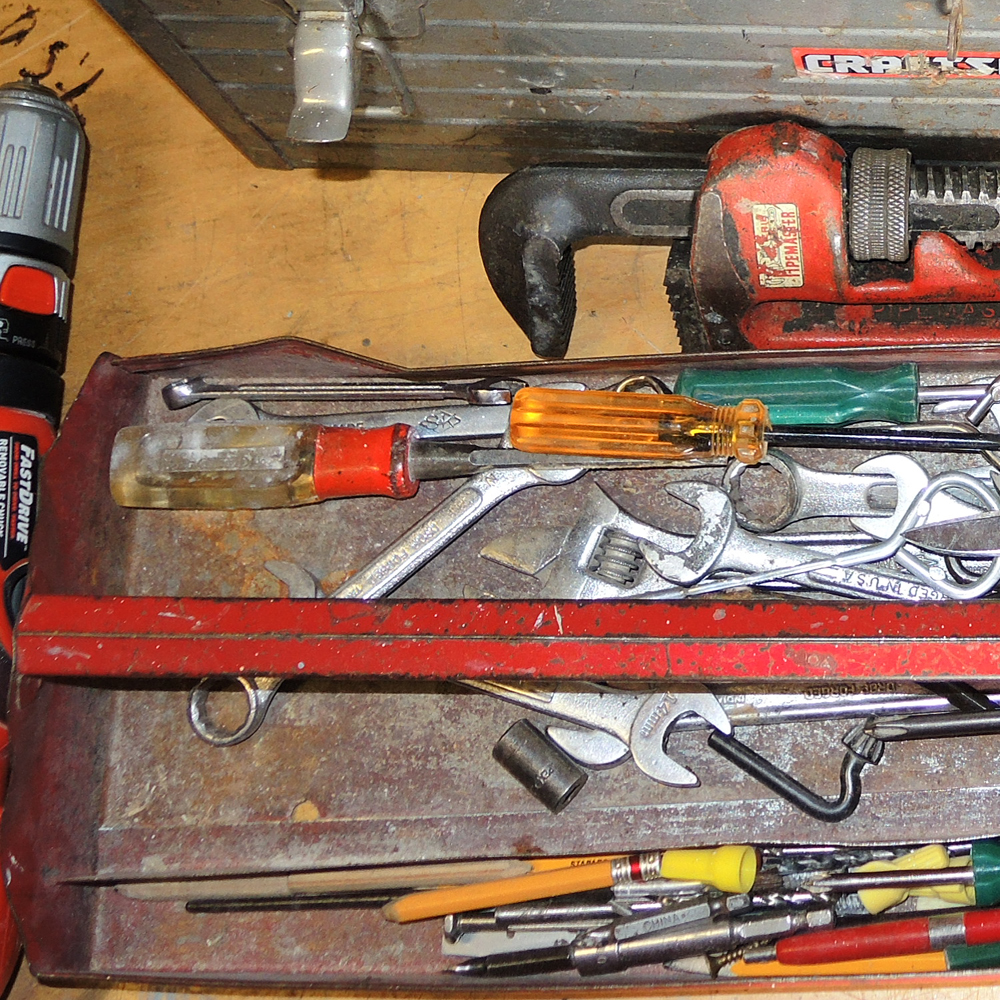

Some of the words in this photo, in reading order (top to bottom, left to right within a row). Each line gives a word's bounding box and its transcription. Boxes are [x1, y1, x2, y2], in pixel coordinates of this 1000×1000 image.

[12, 335, 37, 348] PRESS
[804, 683, 856, 698] FORGED
[643, 914, 681, 931] CHINA
